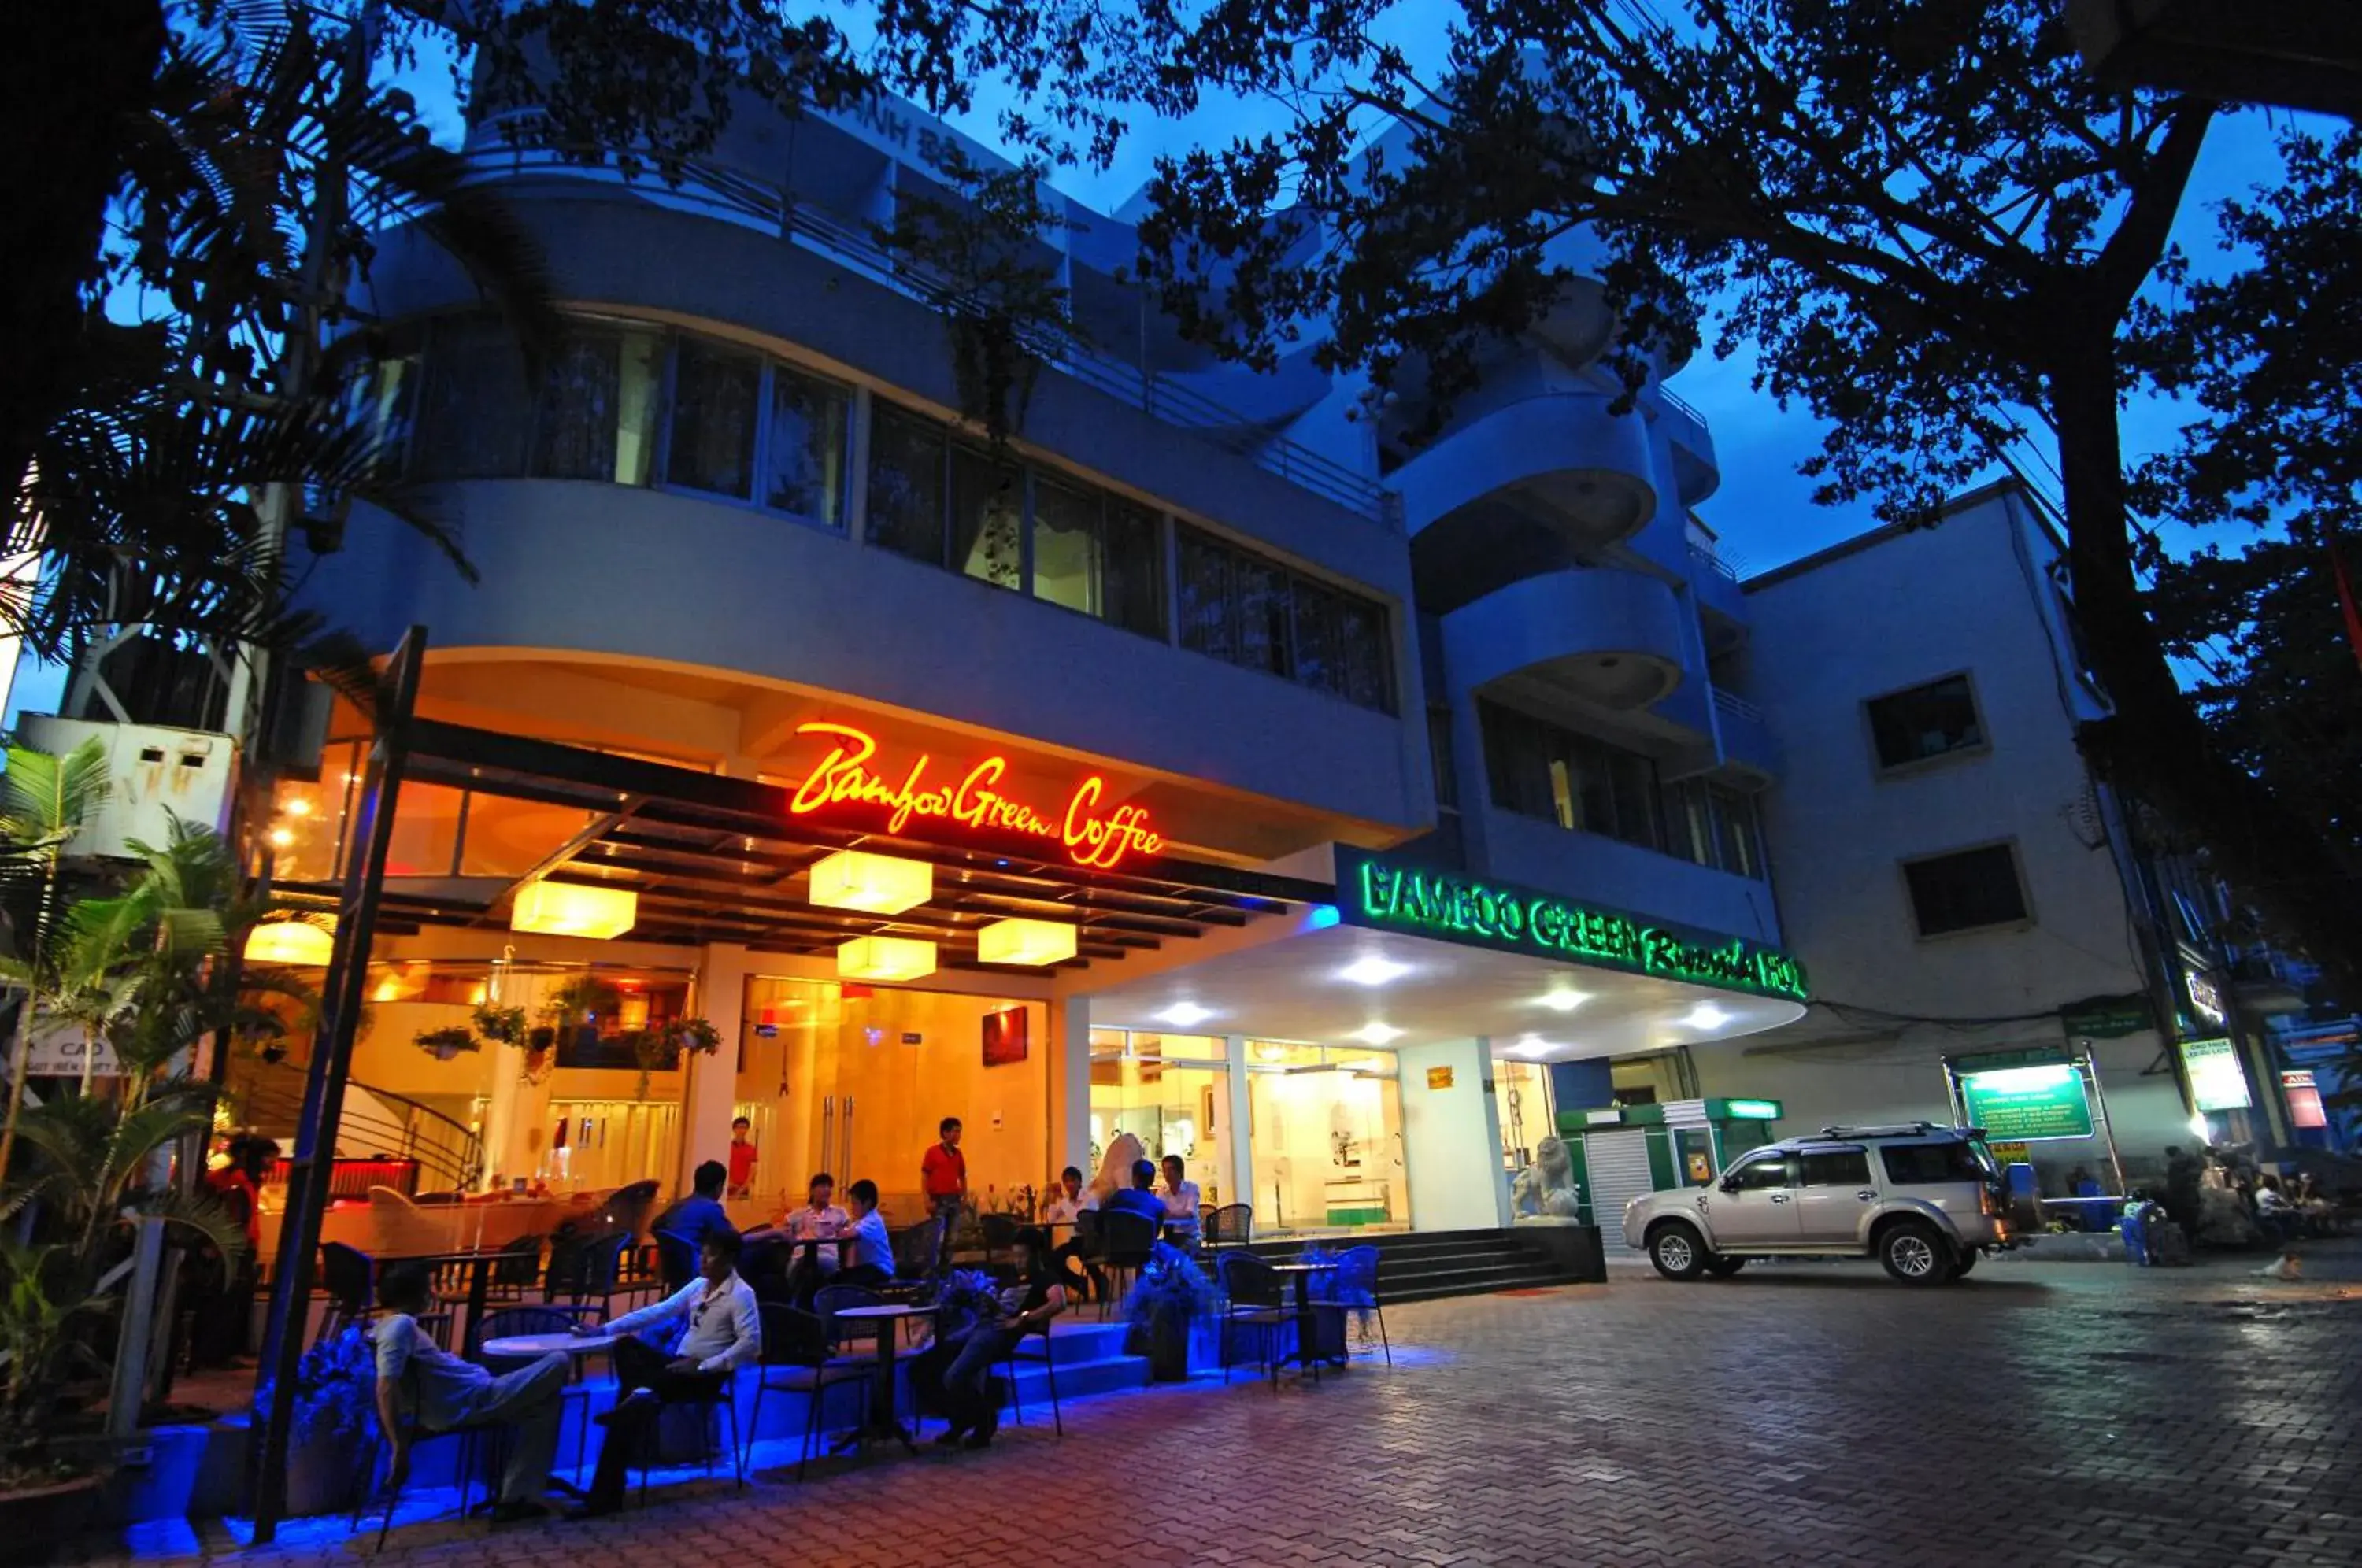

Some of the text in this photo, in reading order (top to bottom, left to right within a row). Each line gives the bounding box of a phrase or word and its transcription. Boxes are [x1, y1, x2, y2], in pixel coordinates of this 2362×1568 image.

[790, 721, 1164, 869] Bamboo Green Coffee
[1529, 900, 1639, 958] GREEN
